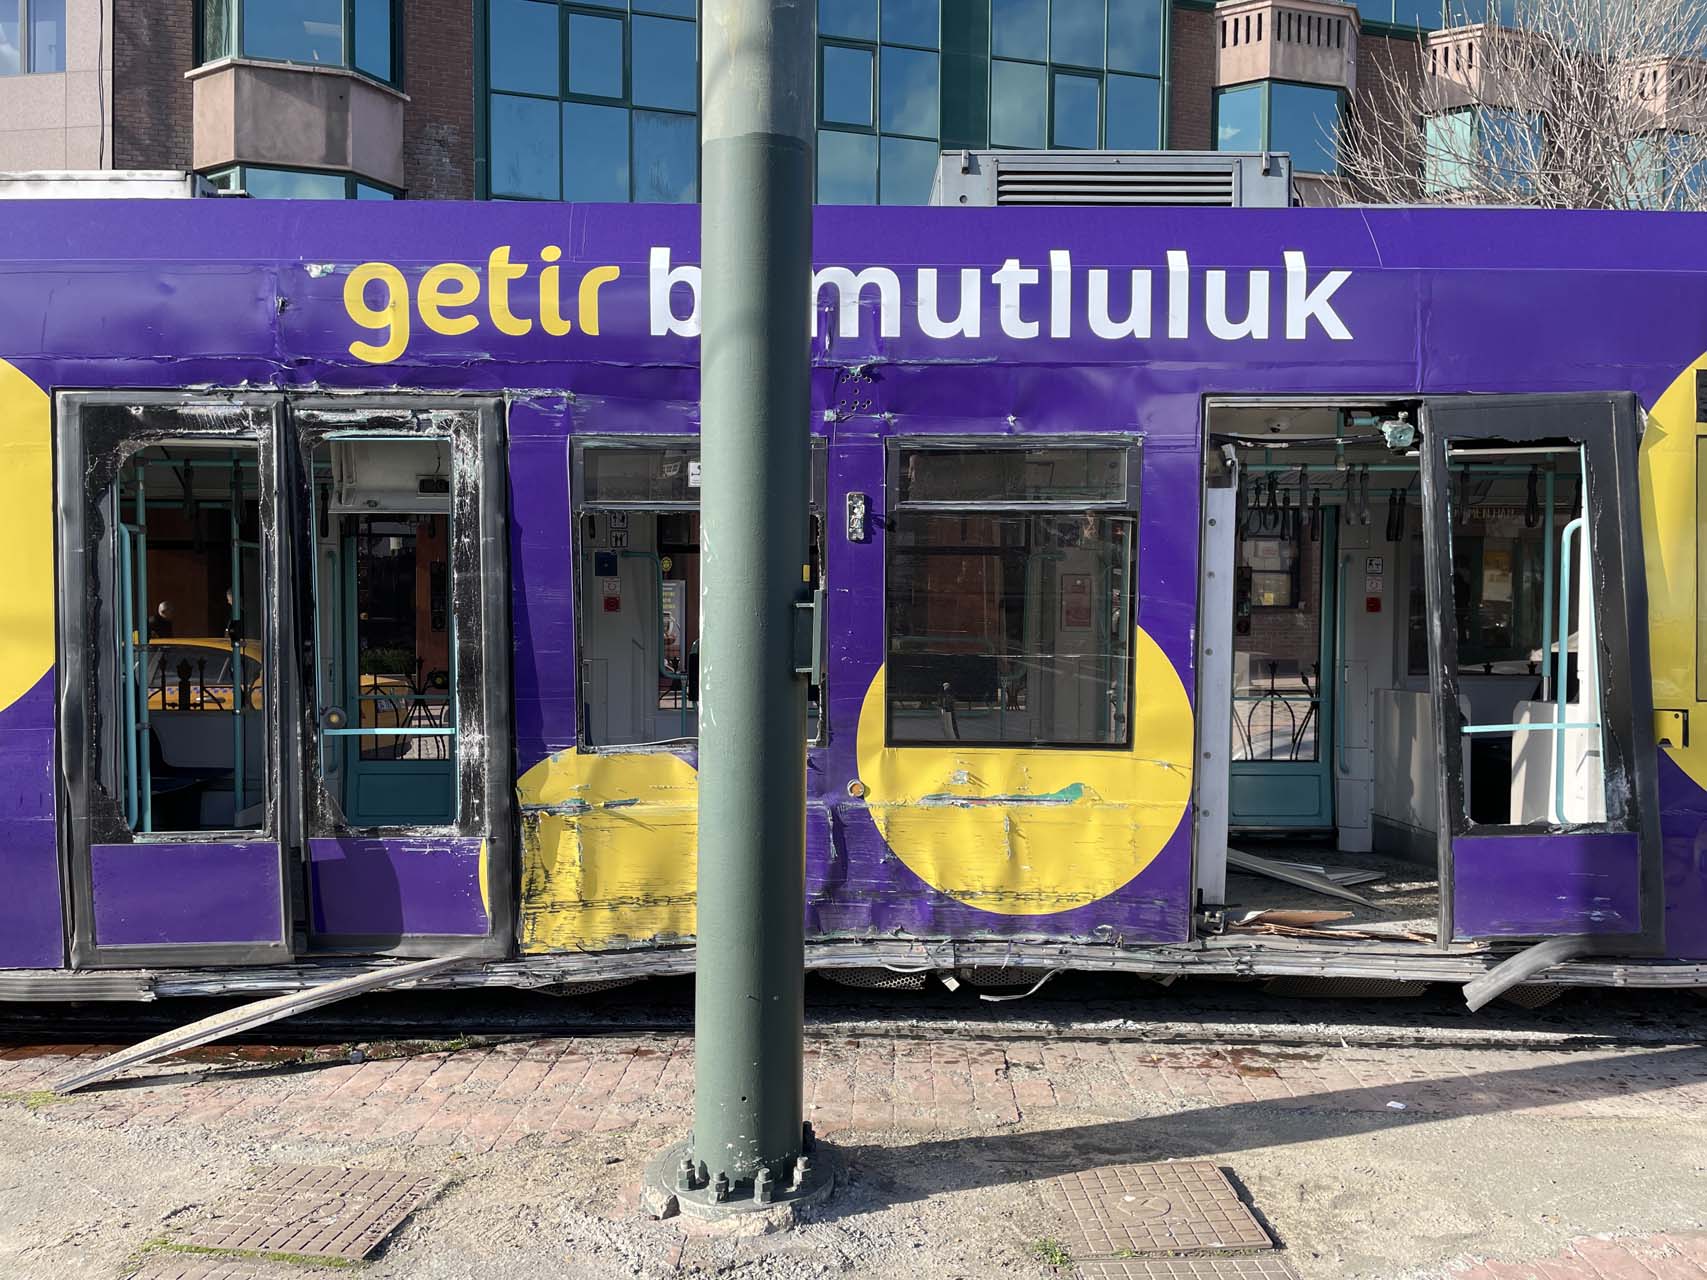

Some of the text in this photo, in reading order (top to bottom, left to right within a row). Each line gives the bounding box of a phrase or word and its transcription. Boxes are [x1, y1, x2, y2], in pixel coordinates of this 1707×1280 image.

[343, 245, 1354, 363] getir b mutluluk
